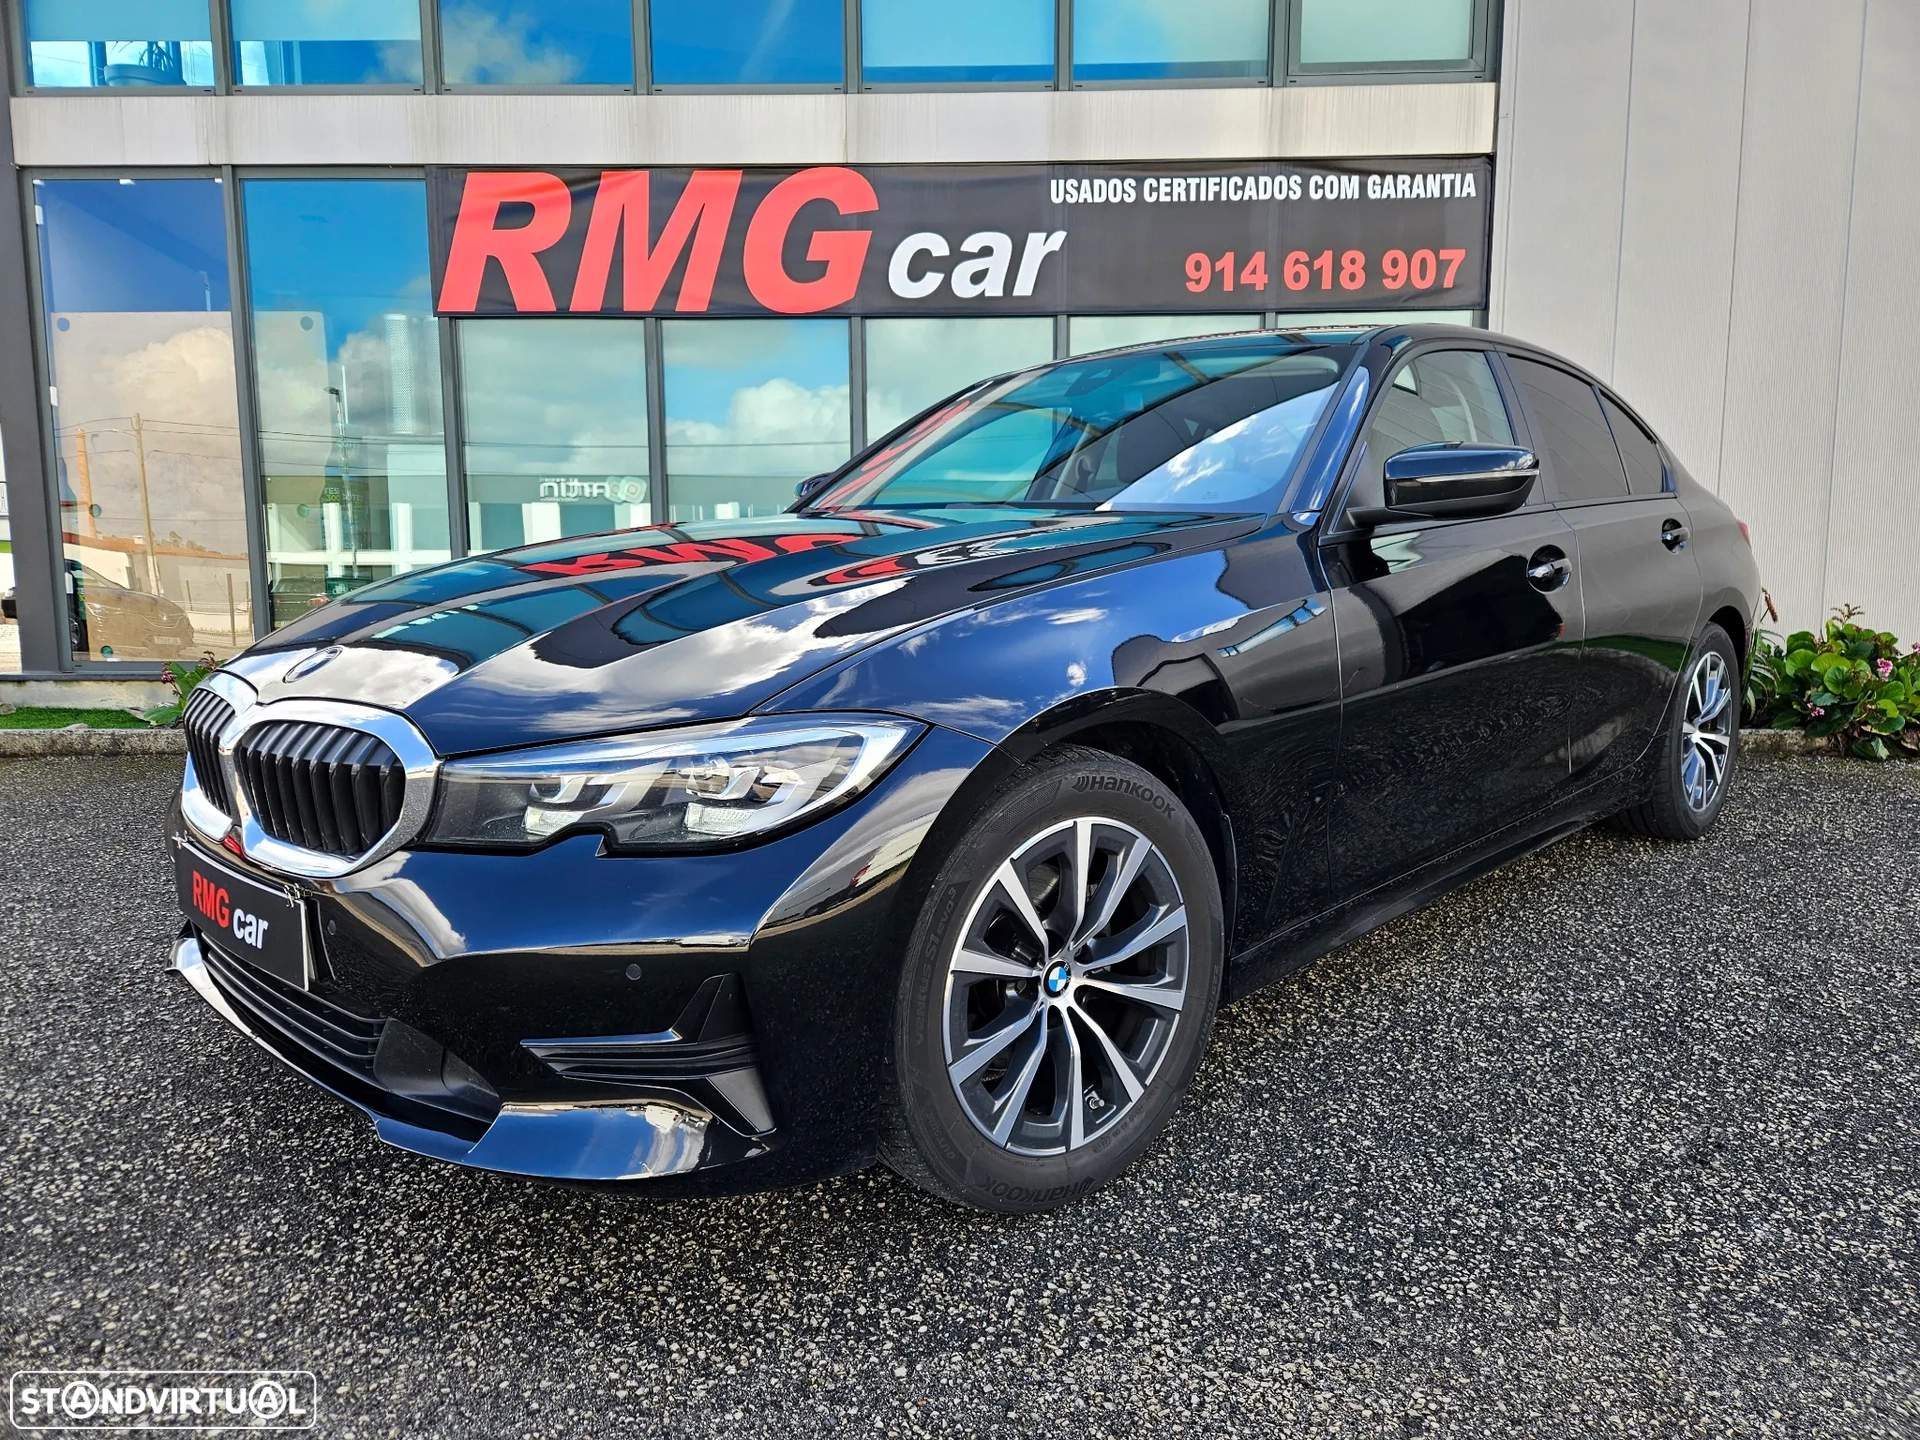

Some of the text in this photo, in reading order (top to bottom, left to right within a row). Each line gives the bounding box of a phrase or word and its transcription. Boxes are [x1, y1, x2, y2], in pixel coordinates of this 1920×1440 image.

[1050, 172, 1477, 204] USADOS CERTIFICADOS COM GARANTIA
[437, 165, 1068, 314] RMG car
[1185, 248, 1467, 292] 914 618 907
[192, 870, 269, 949] RMG car
